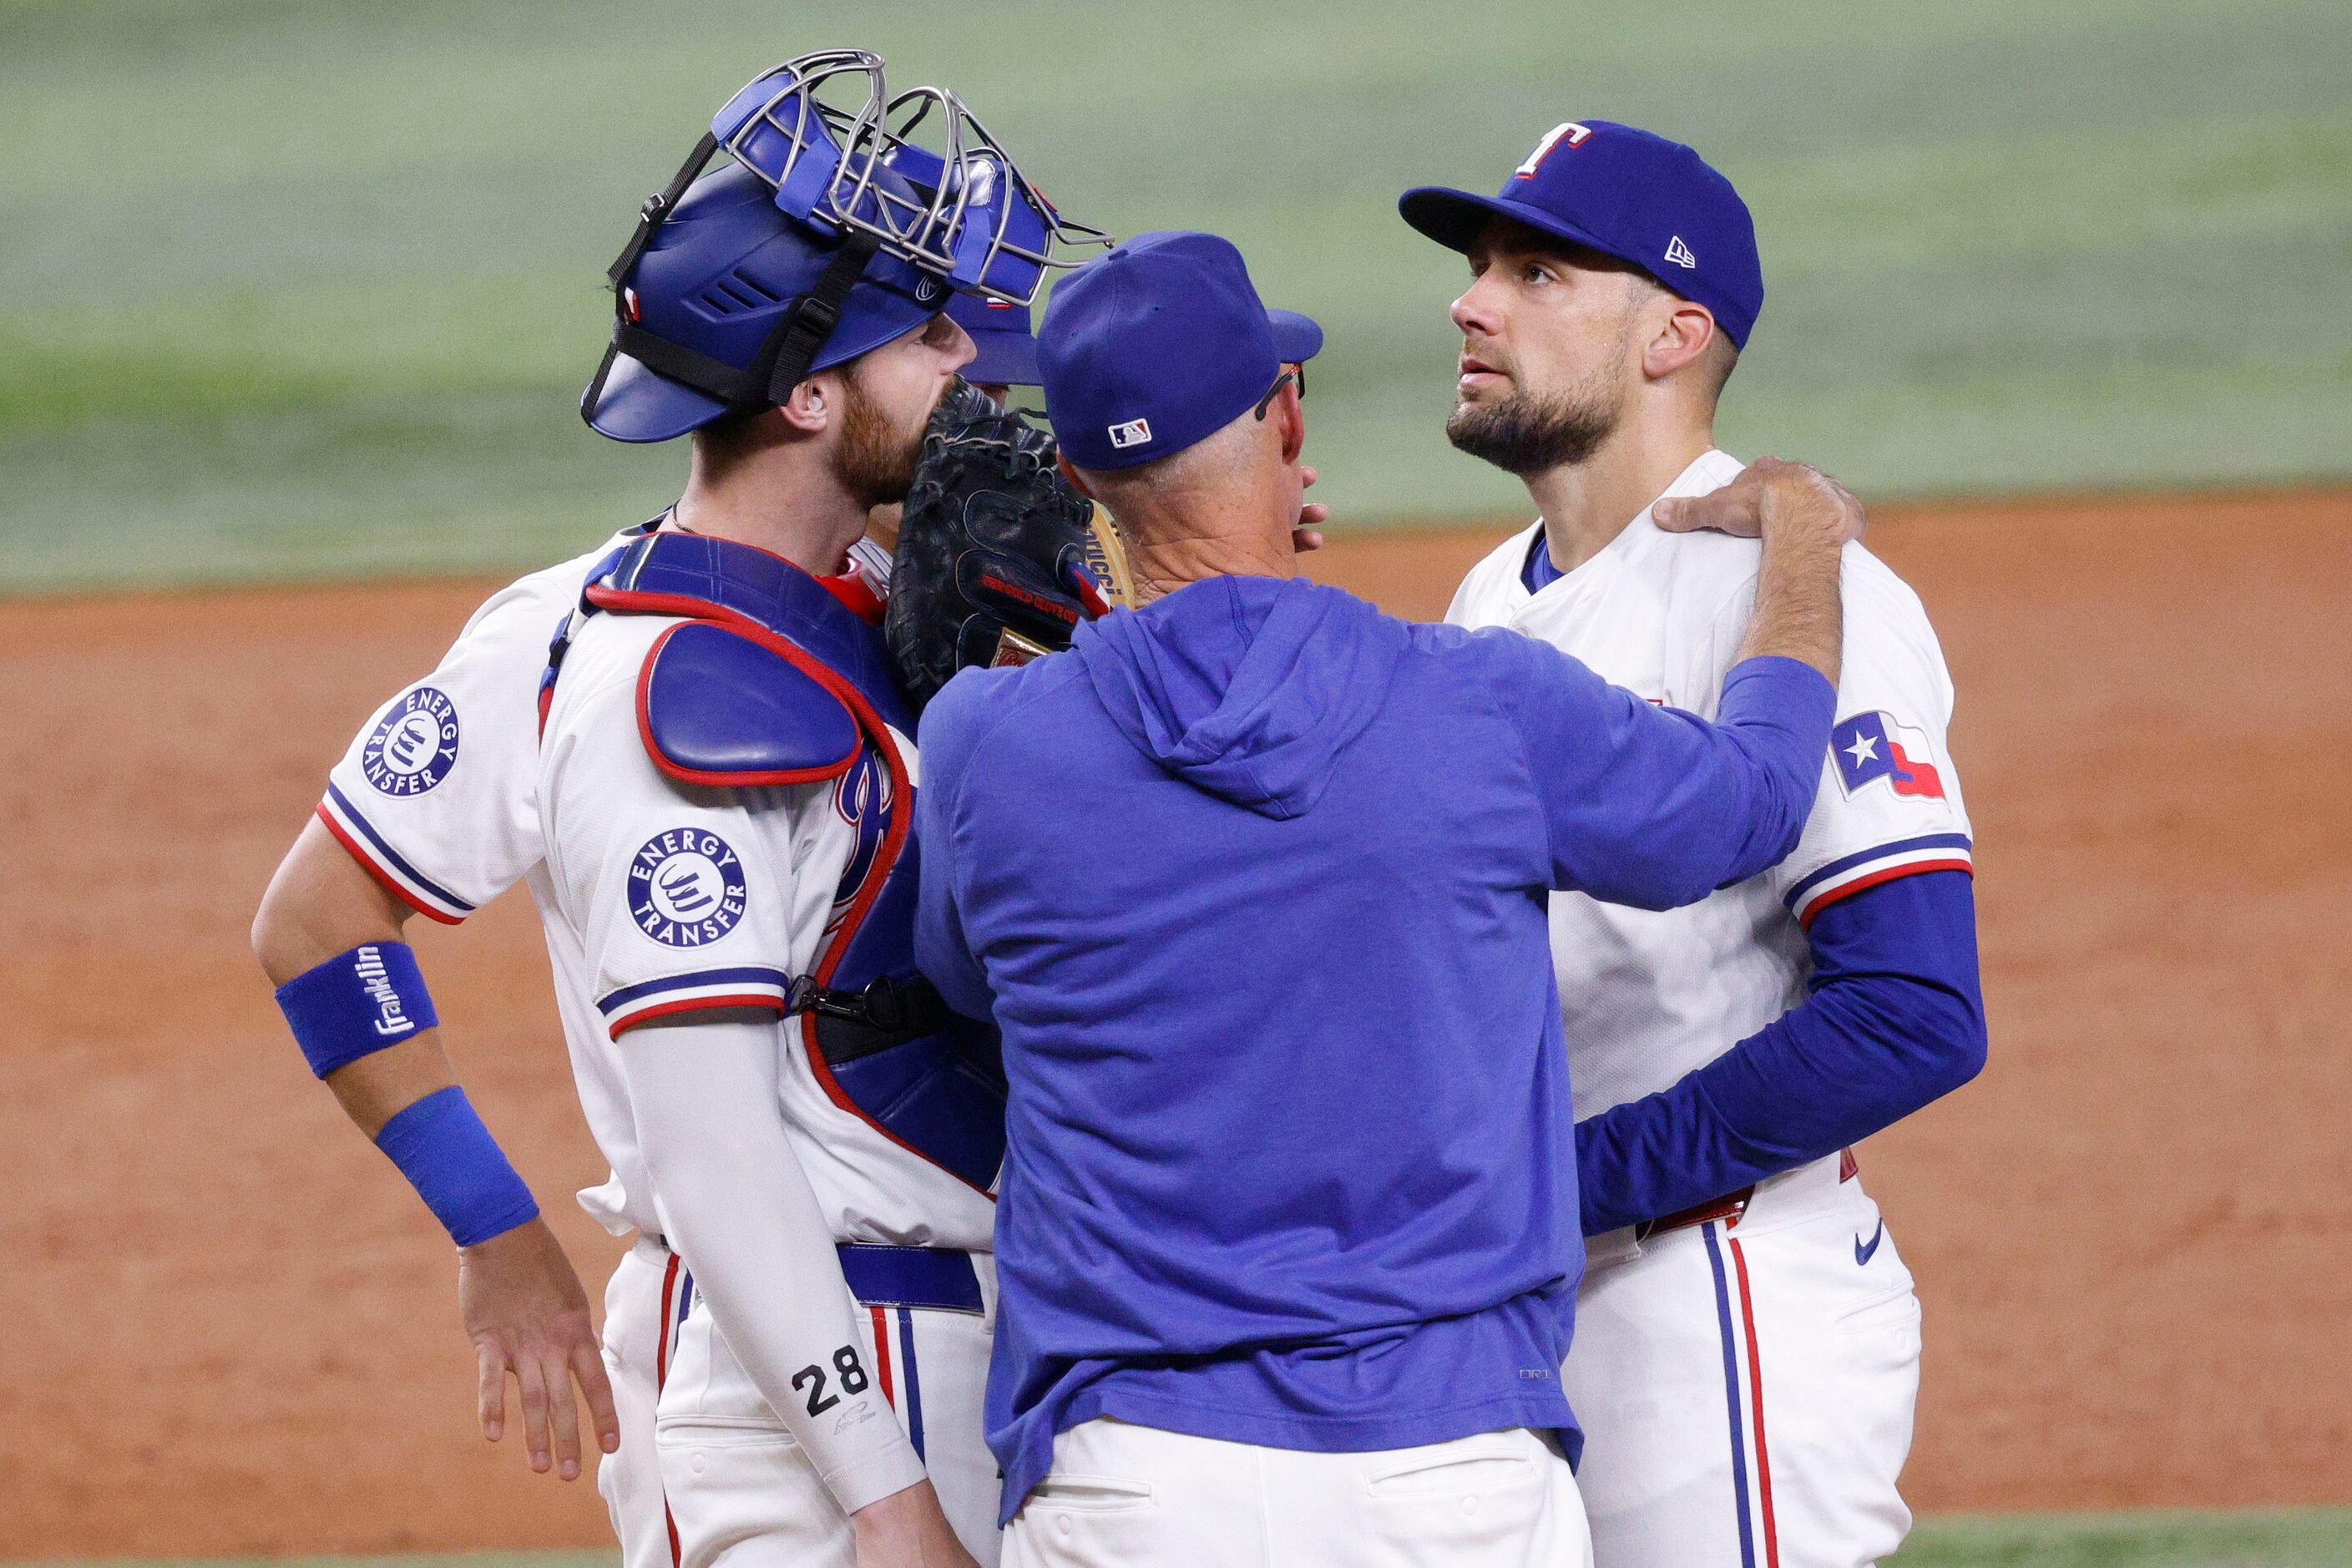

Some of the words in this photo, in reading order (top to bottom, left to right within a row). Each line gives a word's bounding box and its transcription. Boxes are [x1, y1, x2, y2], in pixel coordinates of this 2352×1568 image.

[1515, 123, 1592, 180] T
[1085, 528, 1122, 595] arucci
[365, 723, 438, 794] TRANSFER
[407, 689, 457, 761] ENERGY
[631, 830, 736, 881] ENERGY
[635, 885, 745, 946] TRANSFER
[354, 947, 415, 1034] franklin
[792, 1344, 868, 1418] 28
